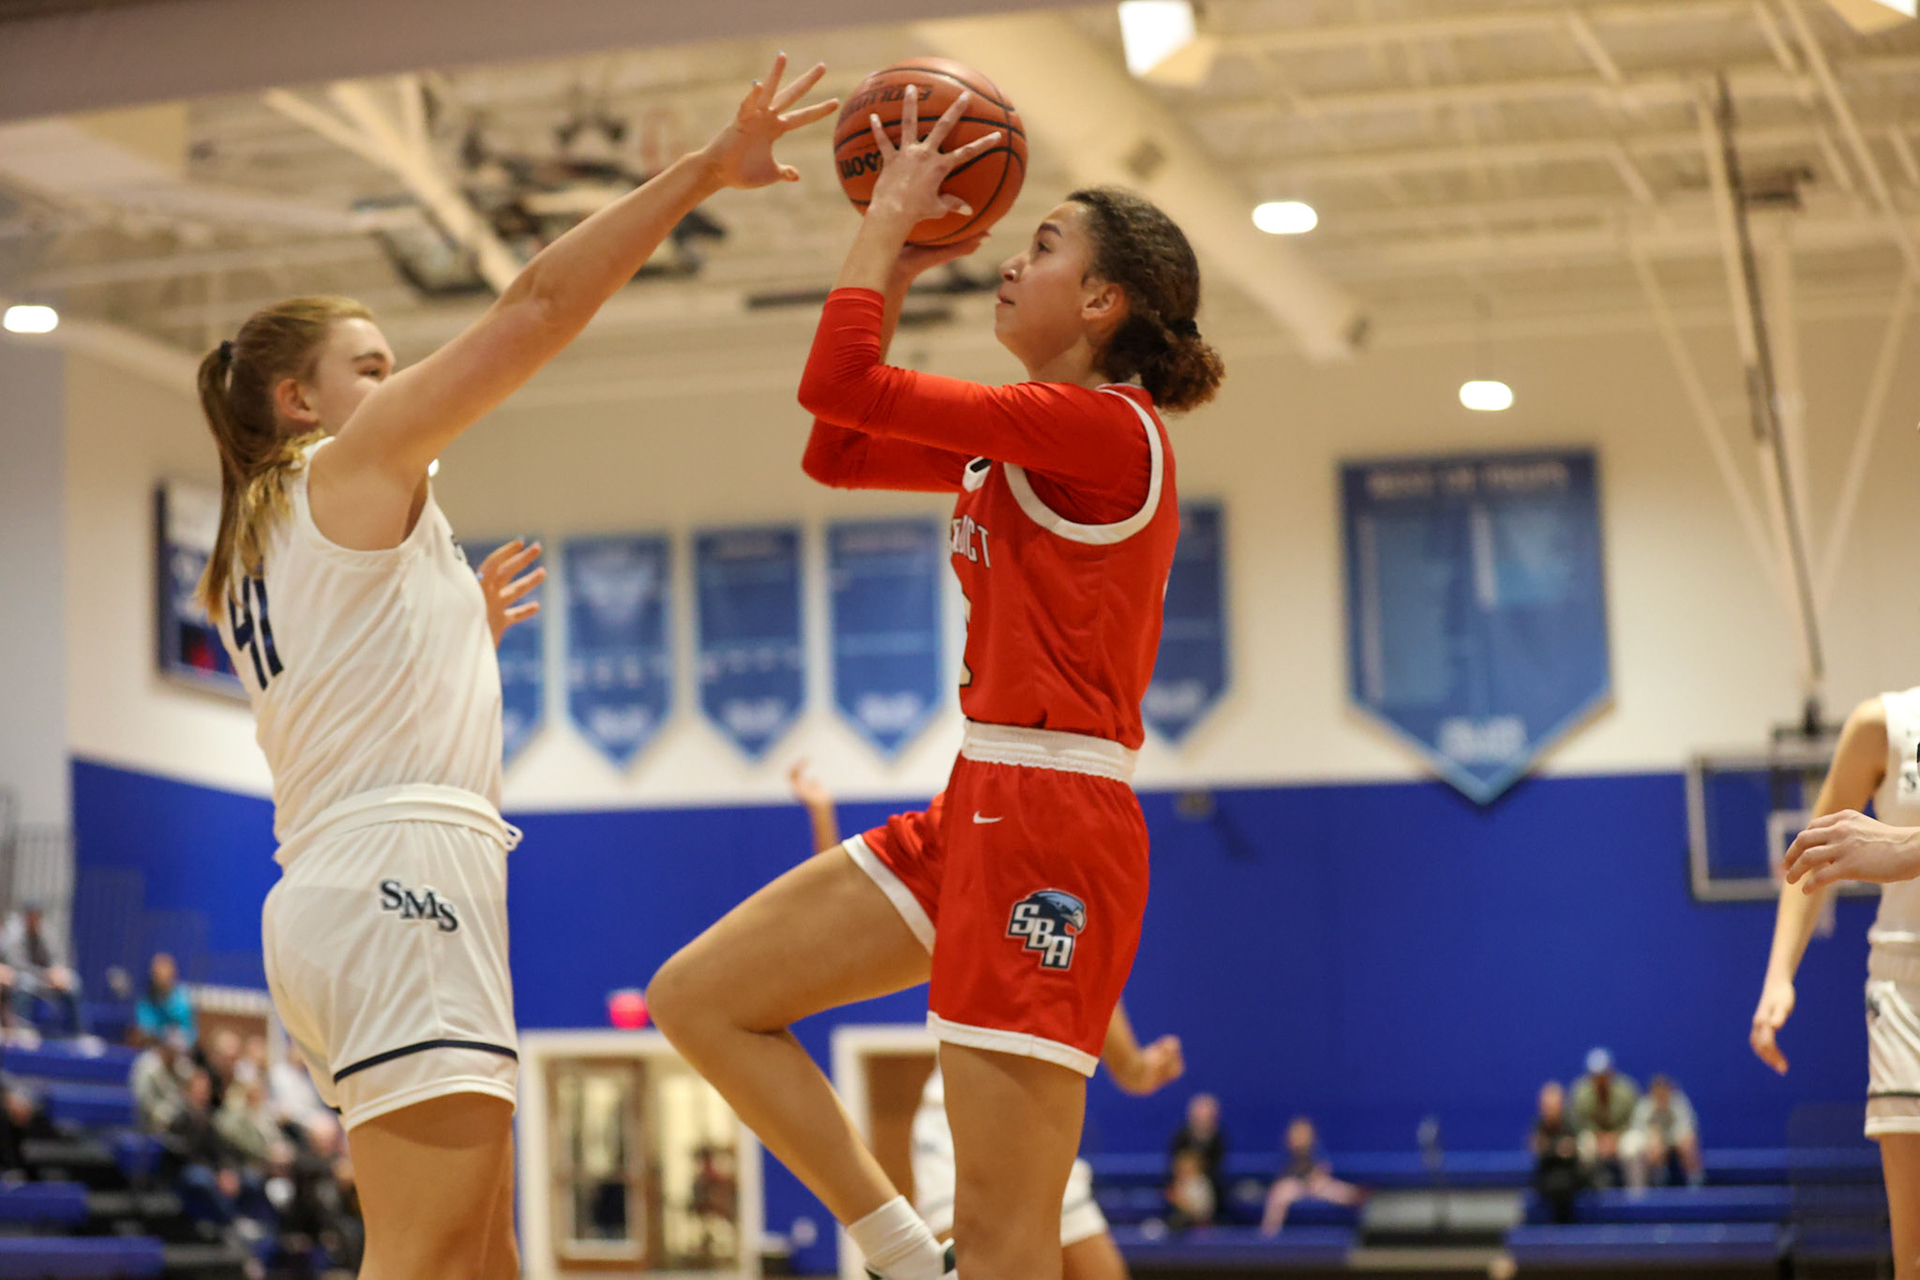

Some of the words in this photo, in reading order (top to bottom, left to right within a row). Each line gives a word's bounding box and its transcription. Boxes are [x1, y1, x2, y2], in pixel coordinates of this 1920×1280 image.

[228, 556, 284, 691] 41
[380, 880, 458, 932] SMS
[1008, 903, 1073, 967] SBA
